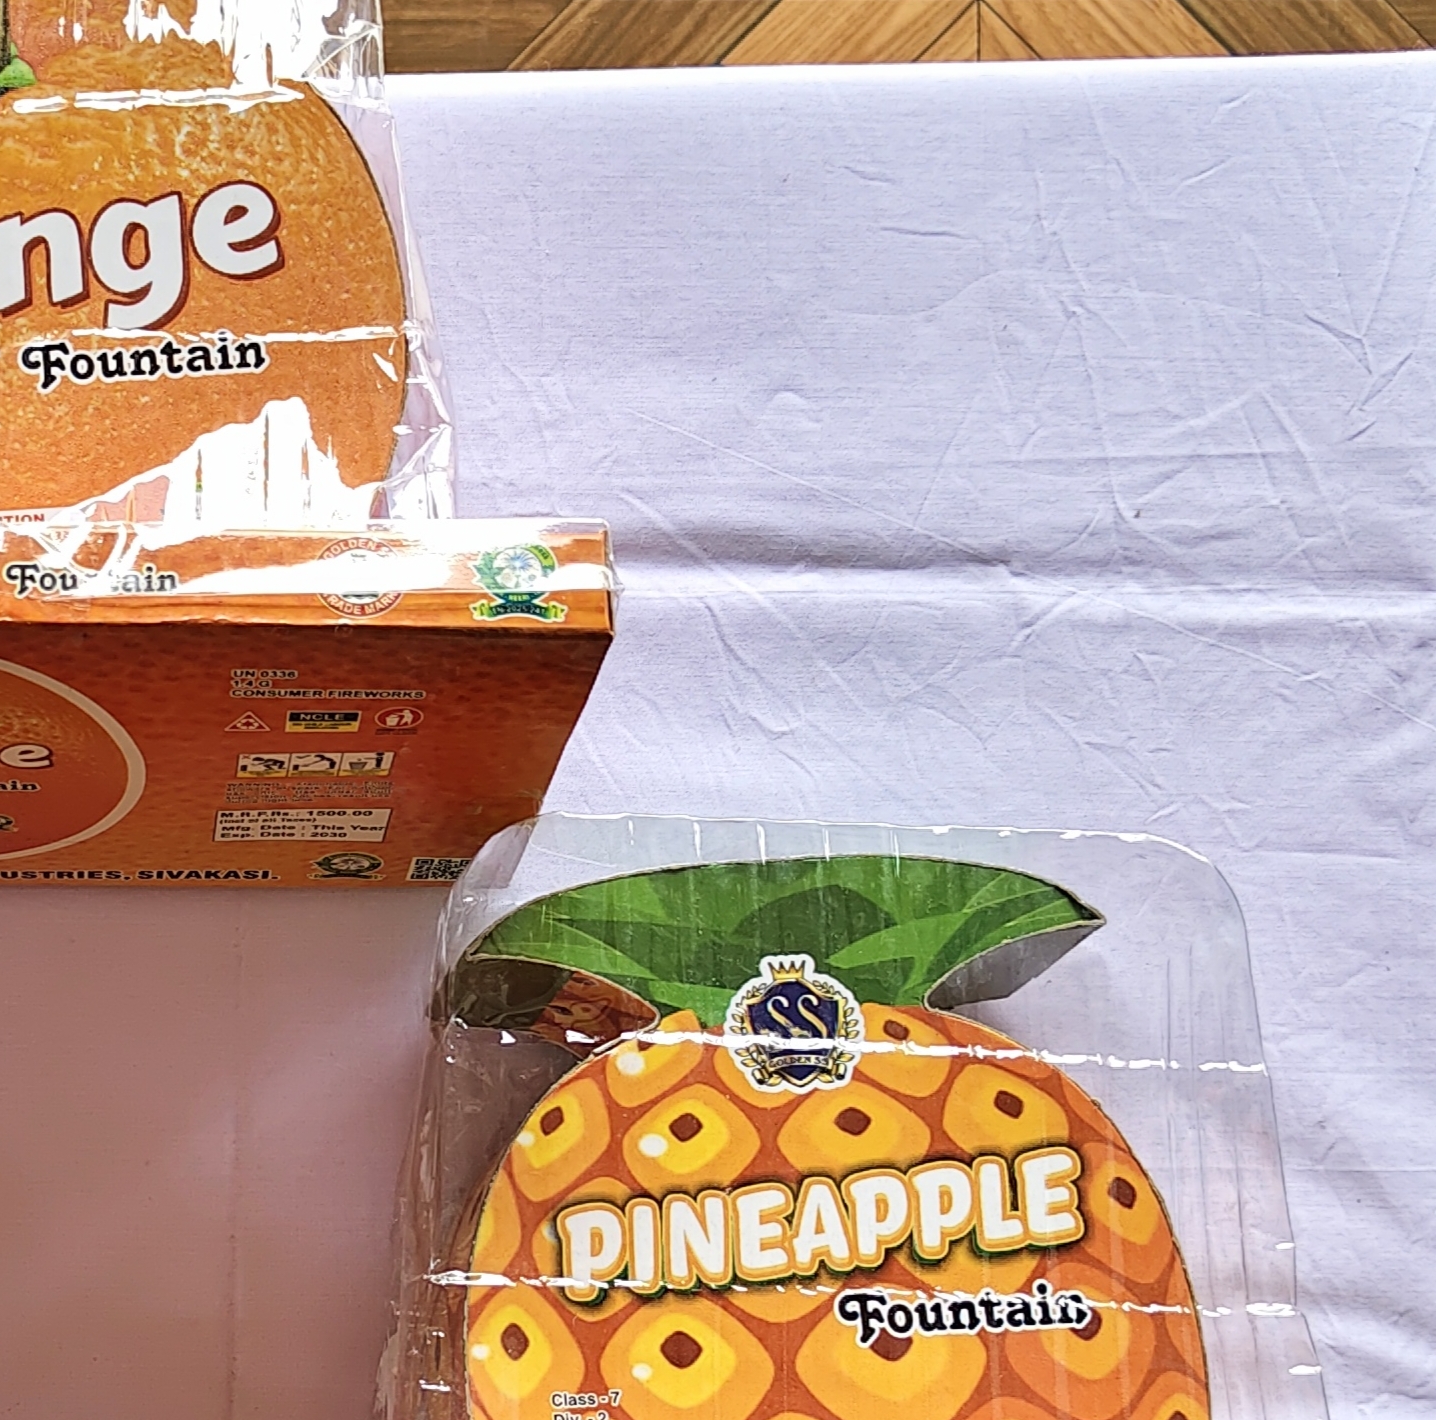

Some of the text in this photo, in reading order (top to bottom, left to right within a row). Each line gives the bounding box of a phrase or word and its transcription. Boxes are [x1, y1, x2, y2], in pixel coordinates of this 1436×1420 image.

[22, 336, 267, 388] Fountain
[233, 670, 256, 678] UN
[231, 689, 424, 699] CONSUMER FIREWORKS
[138, 870, 279, 880] SIVAKASI.
[556, 1148, 1084, 1304] PINEAPPLE
[837, 1281, 1091, 1345] Fountain
[552, 1393, 596, 1407] Class
